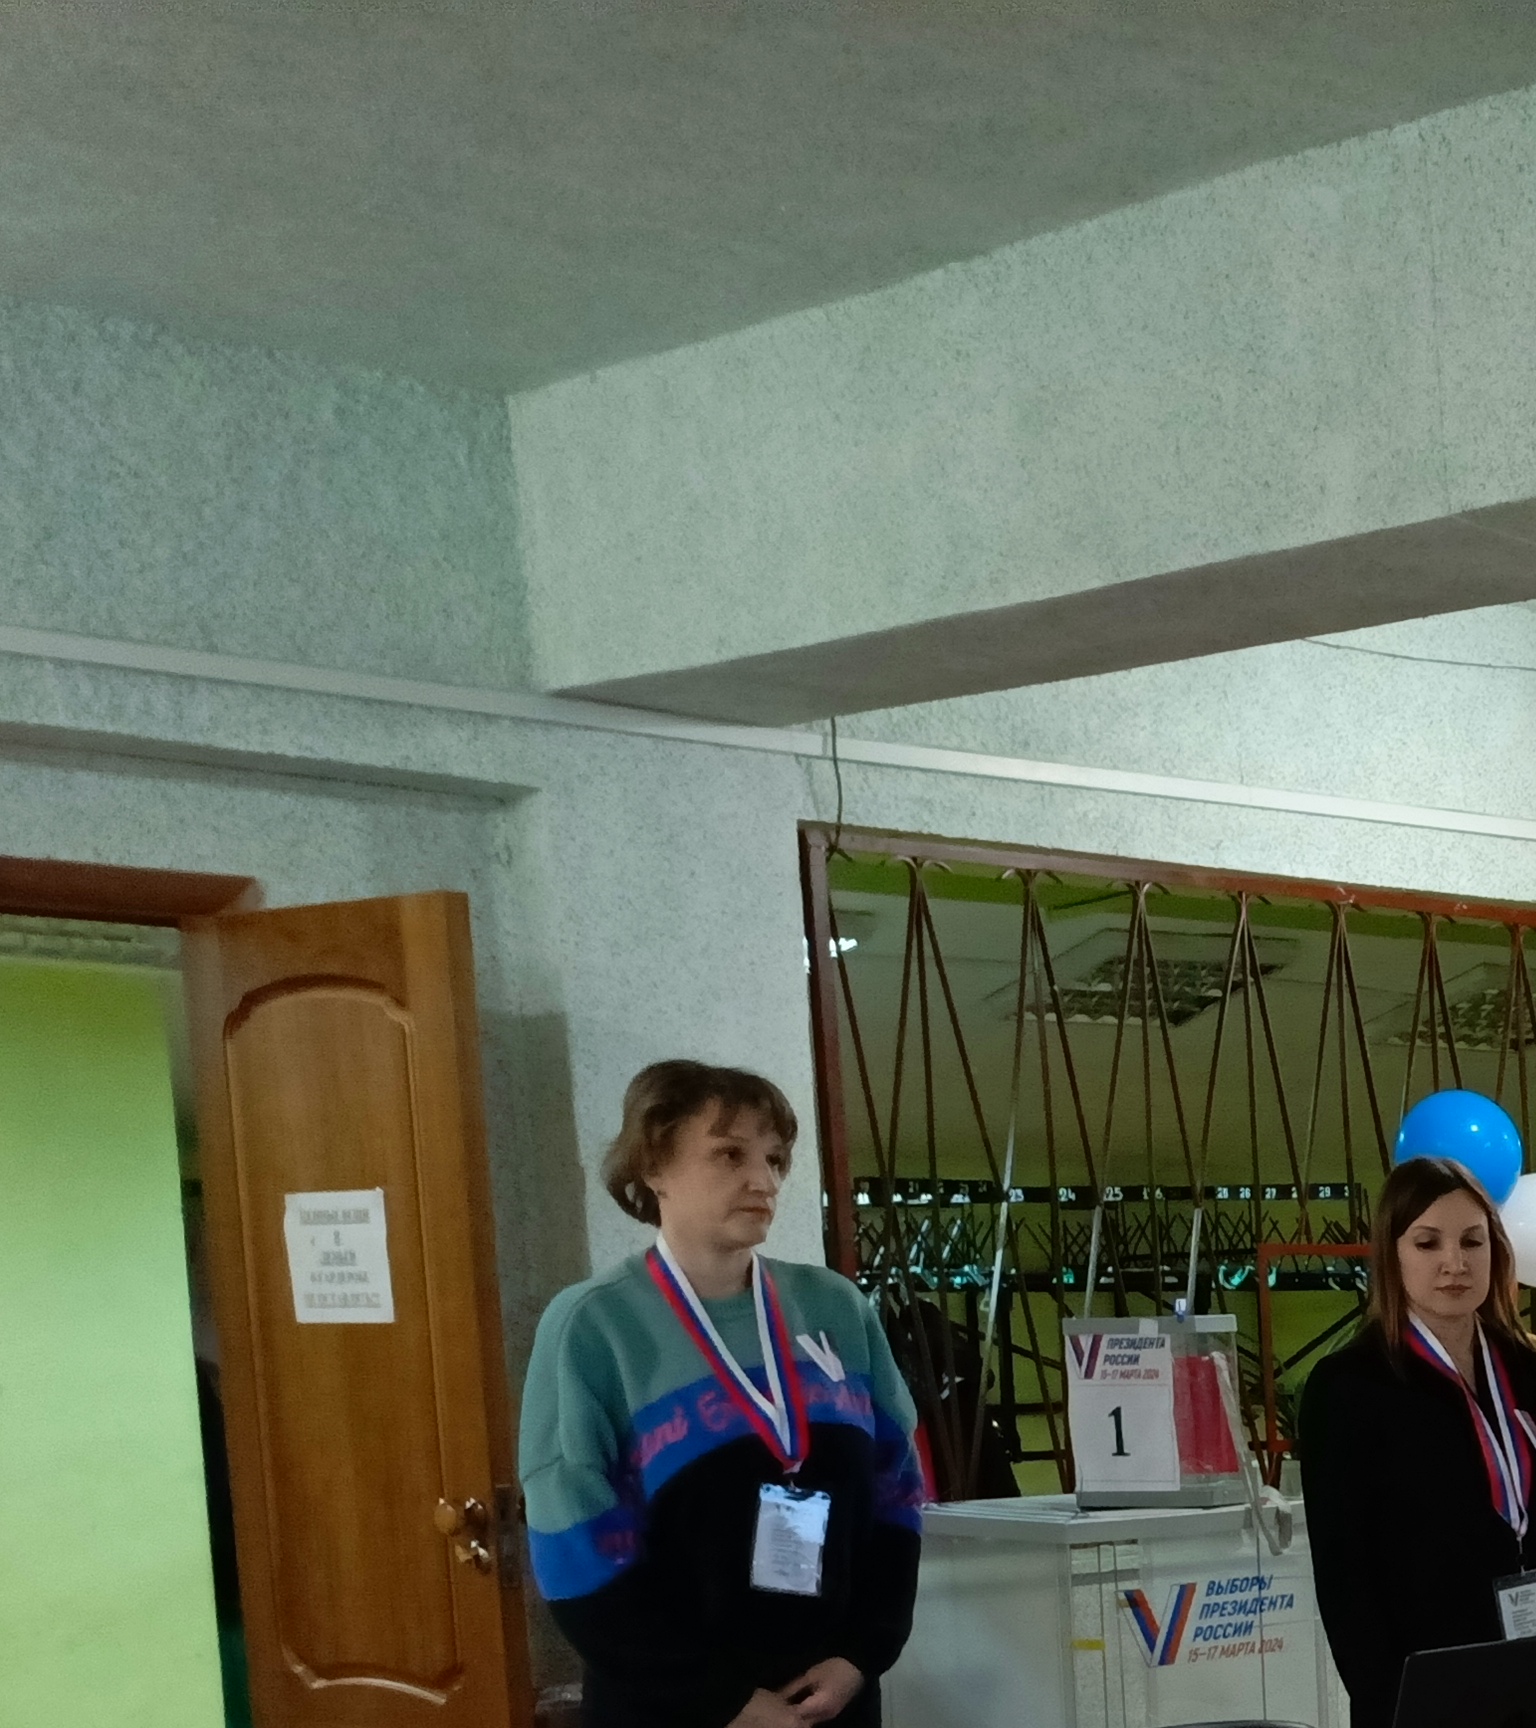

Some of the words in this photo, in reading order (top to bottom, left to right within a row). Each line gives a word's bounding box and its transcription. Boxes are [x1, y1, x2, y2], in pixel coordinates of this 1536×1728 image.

[1106, 1337, 1166, 1351] ПРЕЗИДЕНТА
[1103, 1353, 1141, 1366] РОССИИ
[1119, 1369, 1142, 1380] МАРТА
[1142, 1368, 1160, 1380] 2024
[1108, 1405, 1131, 1457] 1
[1205, 1574, 1273, 1597] ВЫБОРЫ
[1199, 1594, 1294, 1620] ПРЕЗИДЕНТА
[1193, 1620, 1254, 1642] РОССИИ
[1219, 1641, 1256, 1659] МАРТА
[1257, 1637, 1284, 1654] 2024
